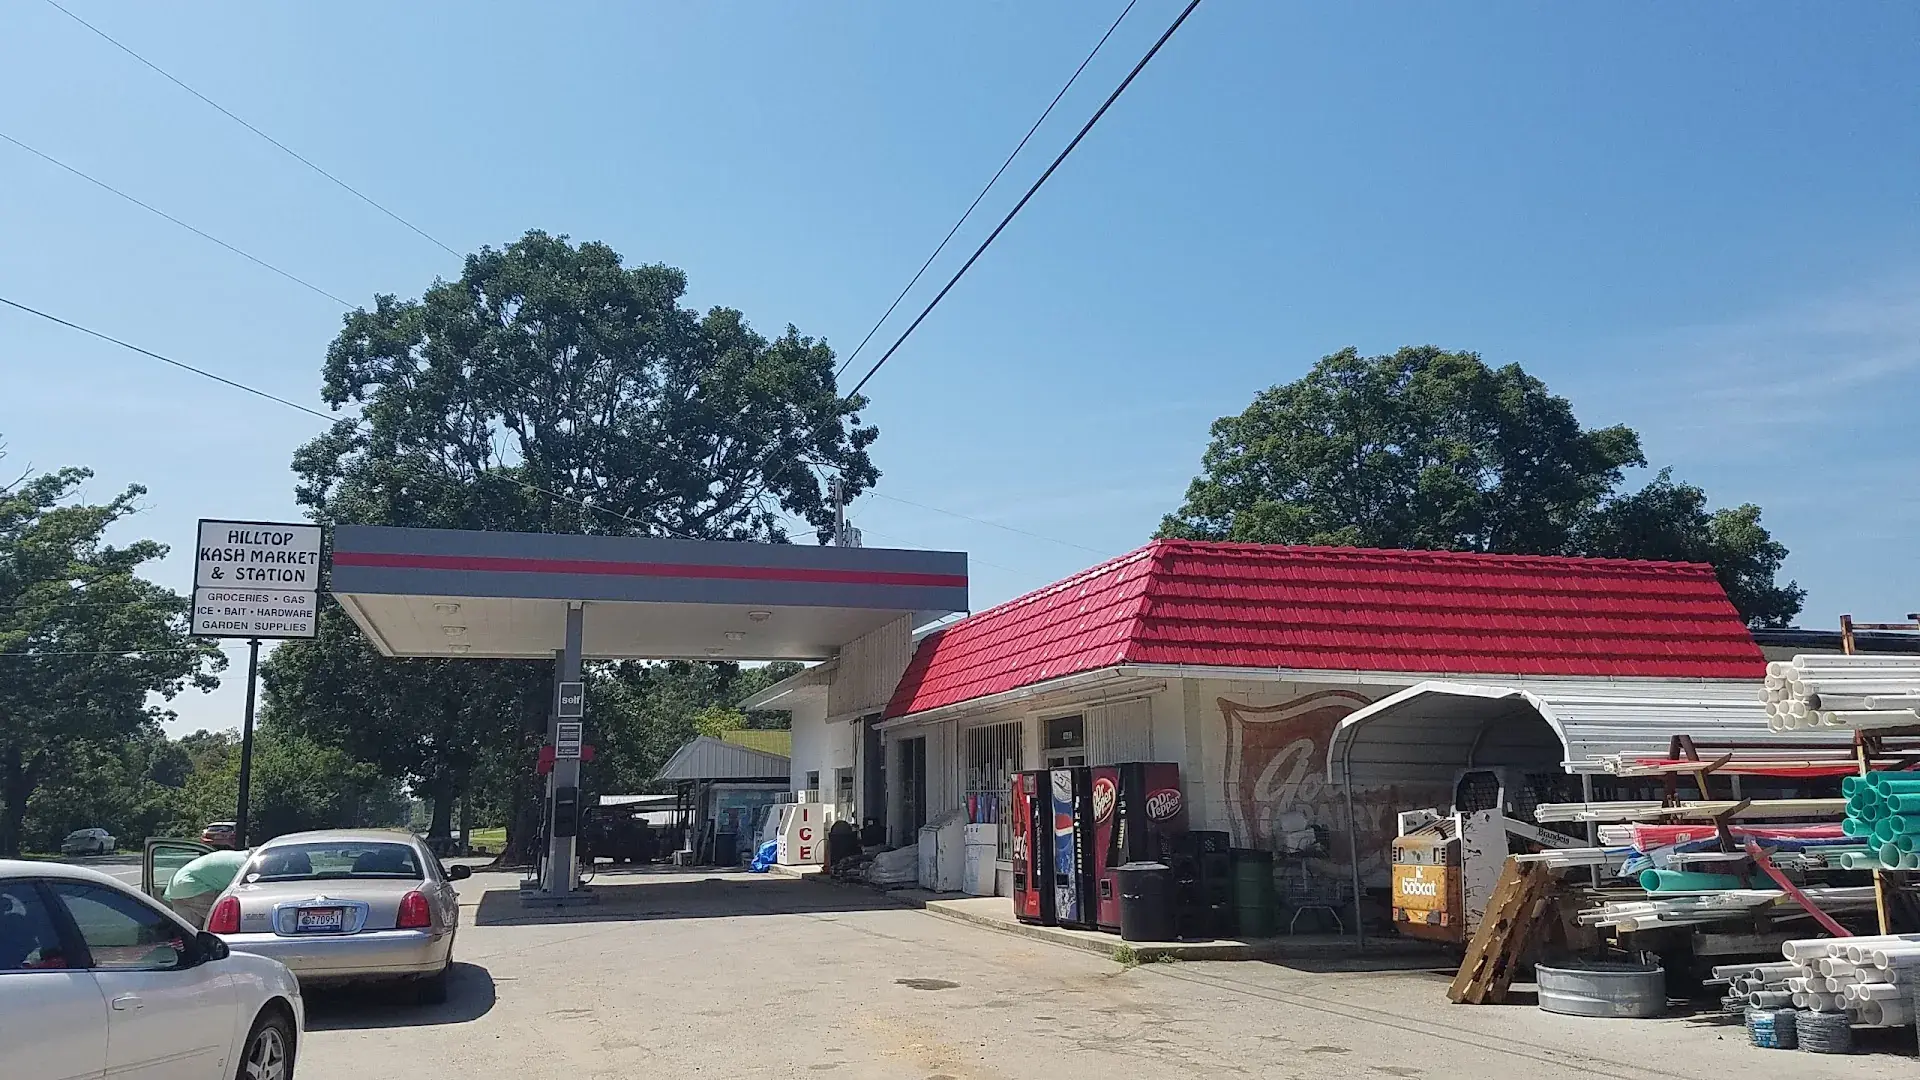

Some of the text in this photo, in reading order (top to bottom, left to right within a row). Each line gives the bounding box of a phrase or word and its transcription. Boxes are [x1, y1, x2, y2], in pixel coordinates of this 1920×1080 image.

[228, 530, 293, 545] HILLTOP
[200, 547, 317, 564] KASH MARKET
[211, 566, 305, 582] & STATION
[207, 592, 305, 604] GROCERIES GAS
[197, 606, 313, 618] ICE BAIT HARDWARE
[202, 620, 307, 631] GARDEN SUPPLIES
[561, 695, 581, 704] self
[1157, 792, 1171, 805] Dr
[1148, 796, 1180, 819] Pepper
[799, 808, 812, 860] ICE
[1538, 827, 1570, 845] Brandeis
[1402, 876, 1436, 896] bobcat
